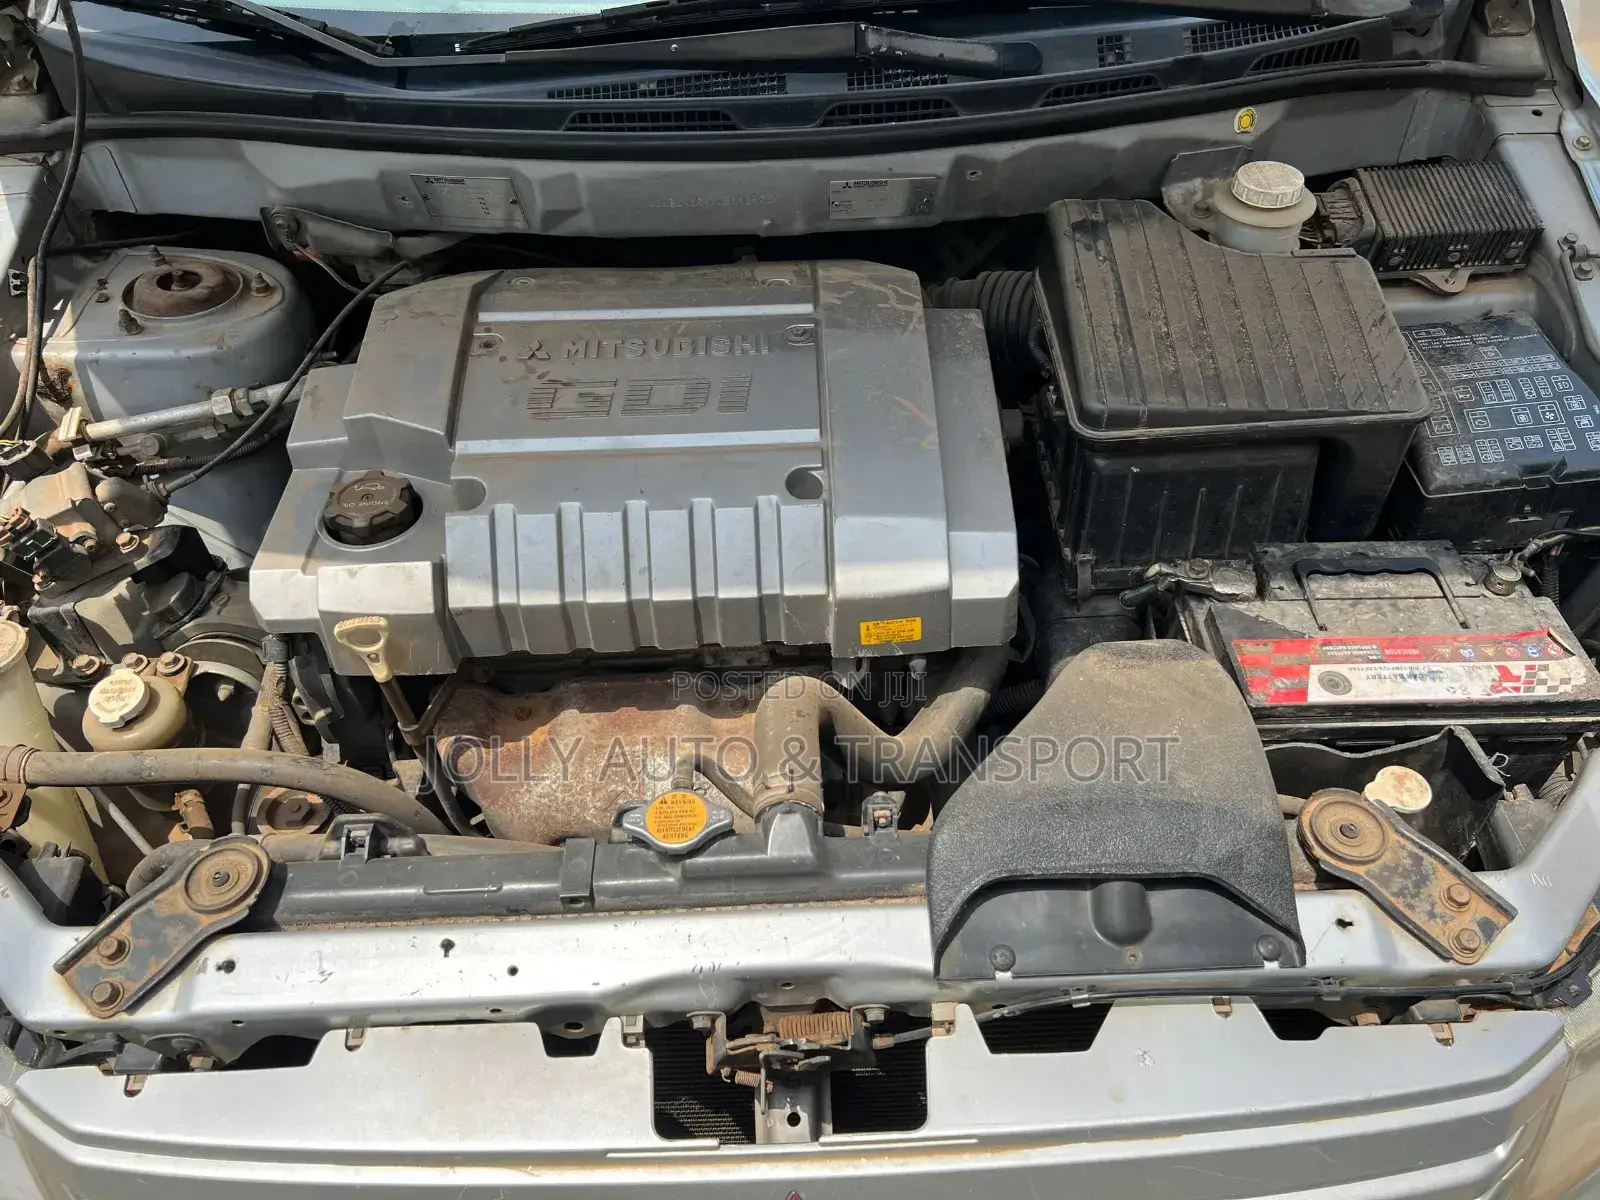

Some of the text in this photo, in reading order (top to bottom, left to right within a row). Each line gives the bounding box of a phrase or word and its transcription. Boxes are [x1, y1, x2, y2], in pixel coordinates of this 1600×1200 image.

[562, 334, 771, 361] MITSUBISHI
[525, 373, 753, 419] GDI
[1365, 672, 1426, 681] CAR BATTERY
[656, 825, 695, 833] AVERTISSEMENT
